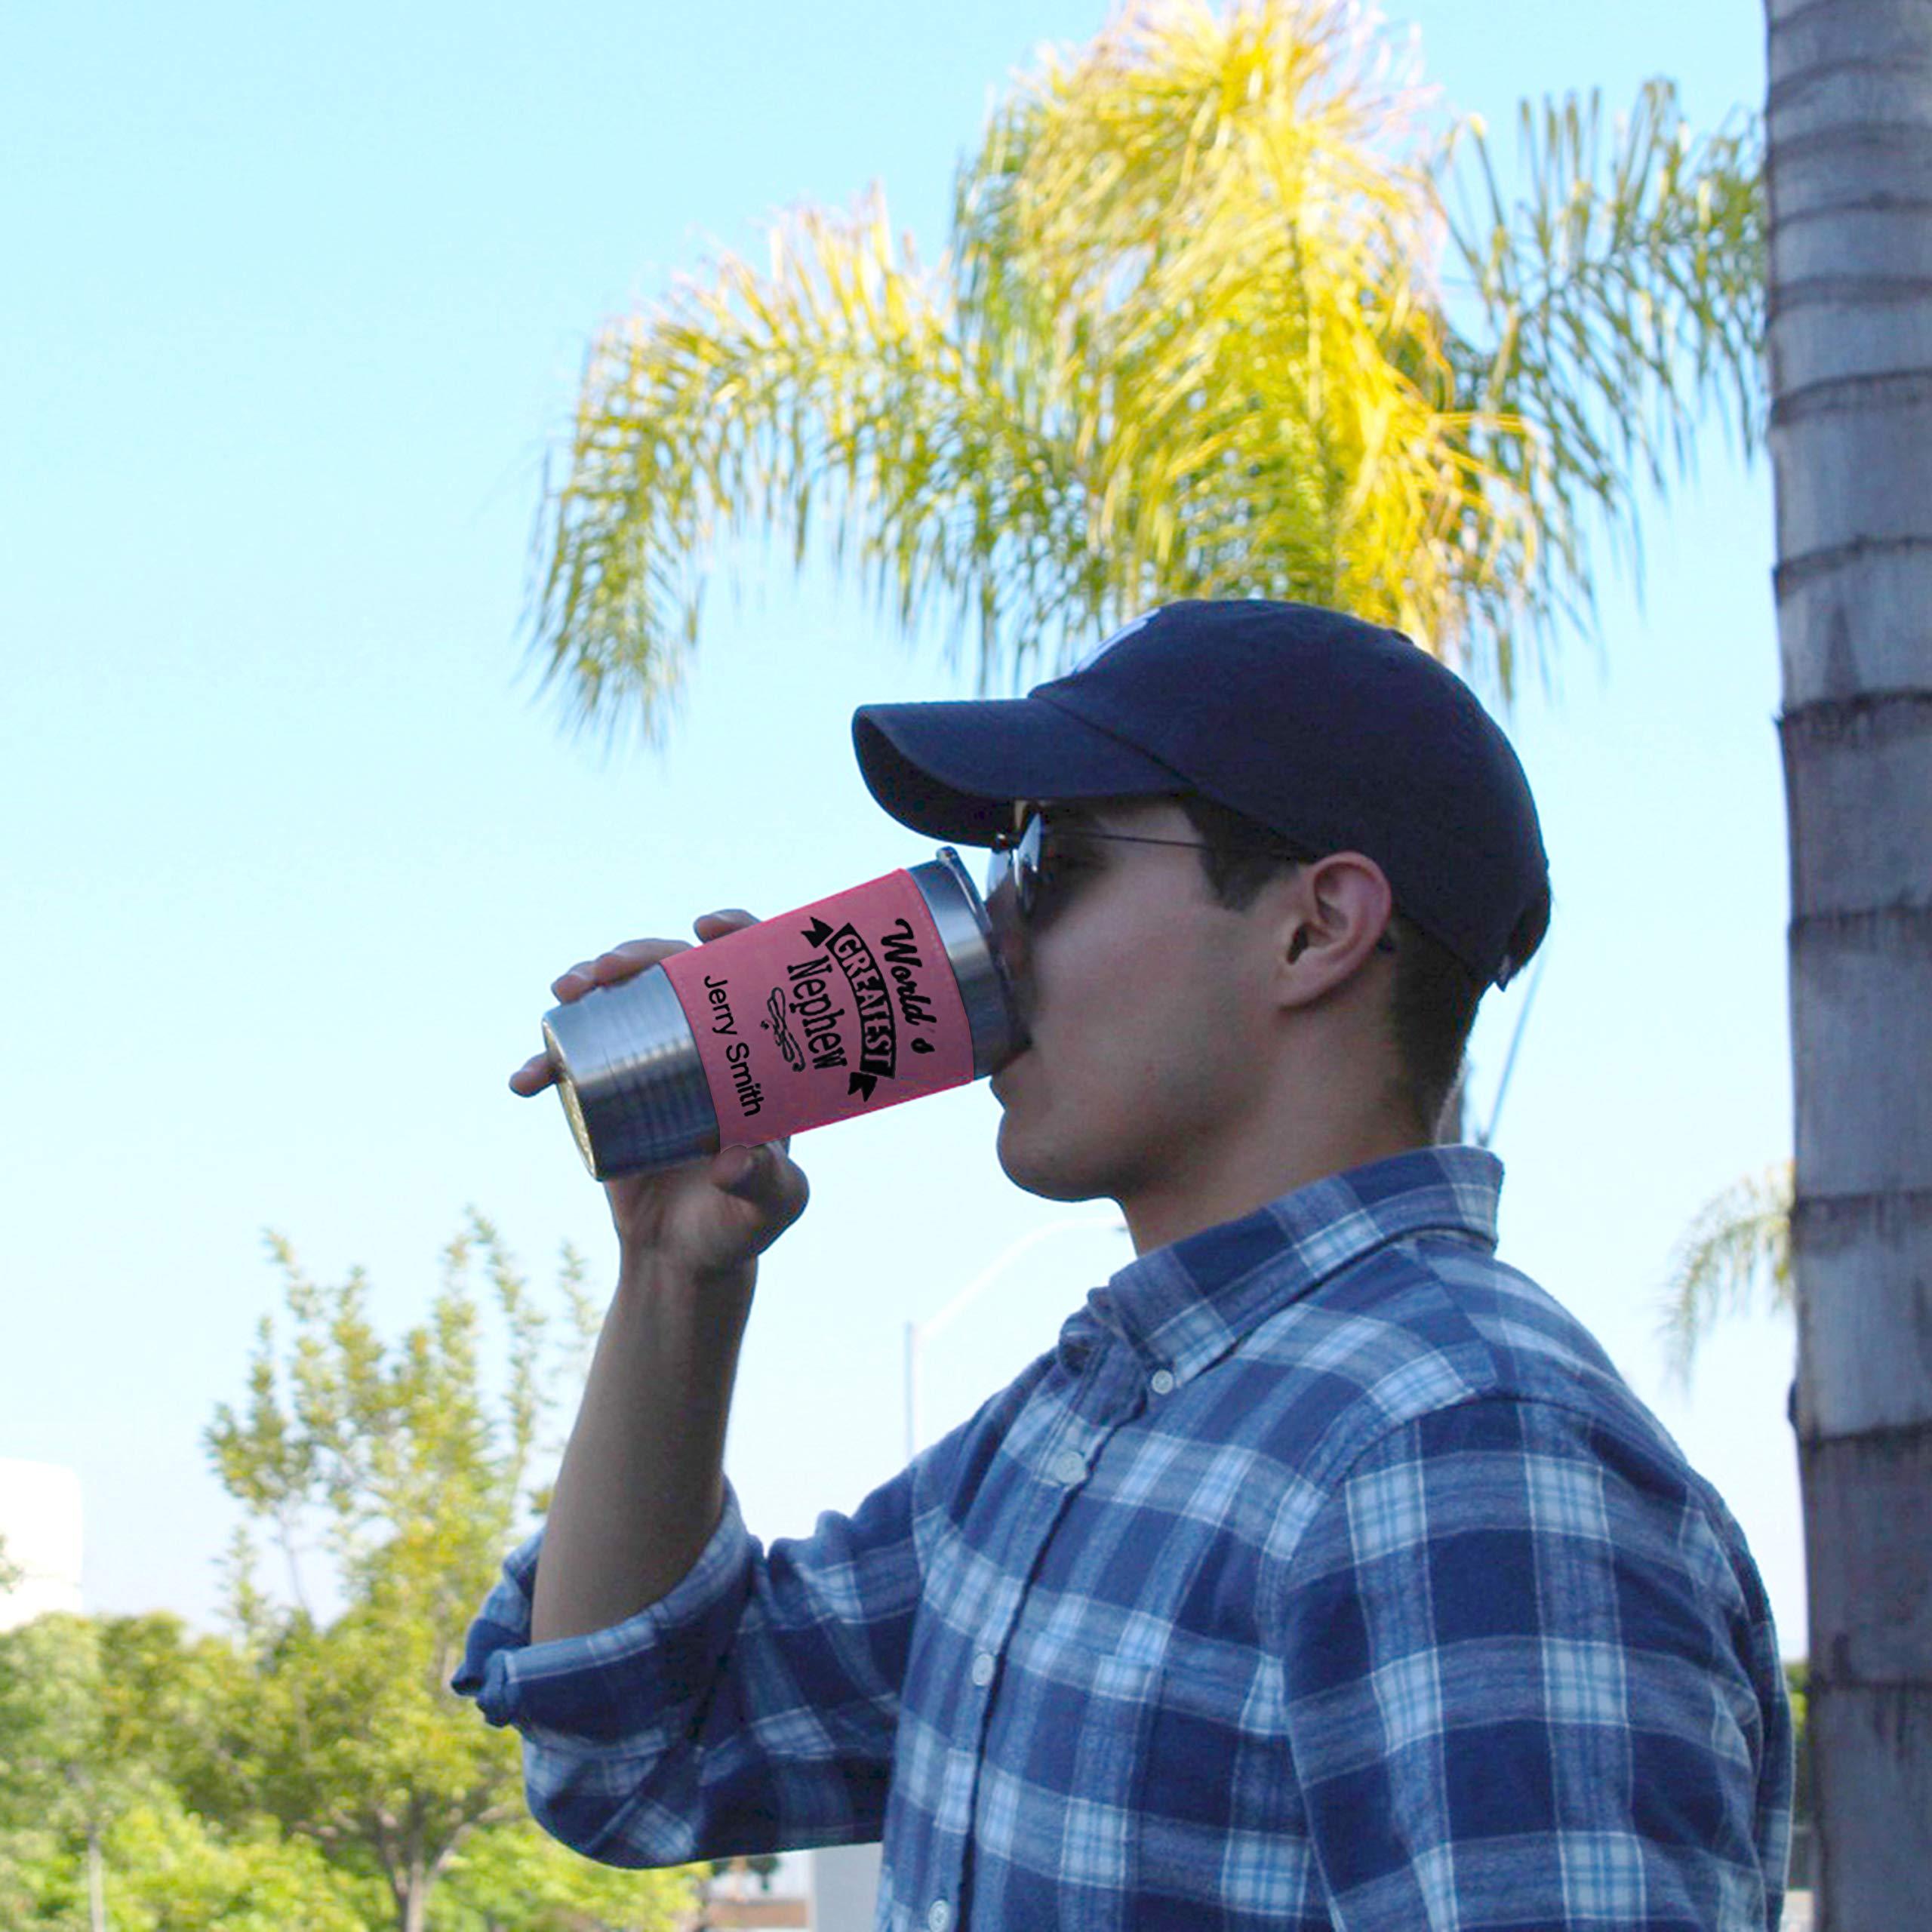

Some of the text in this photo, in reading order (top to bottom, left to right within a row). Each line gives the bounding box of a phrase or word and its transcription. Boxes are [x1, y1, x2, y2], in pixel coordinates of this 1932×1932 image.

[704, 975, 764, 1117] Jerry Smith
[787, 955, 848, 1070] Nephew
[833, 934, 892, 1069] GREATEST
